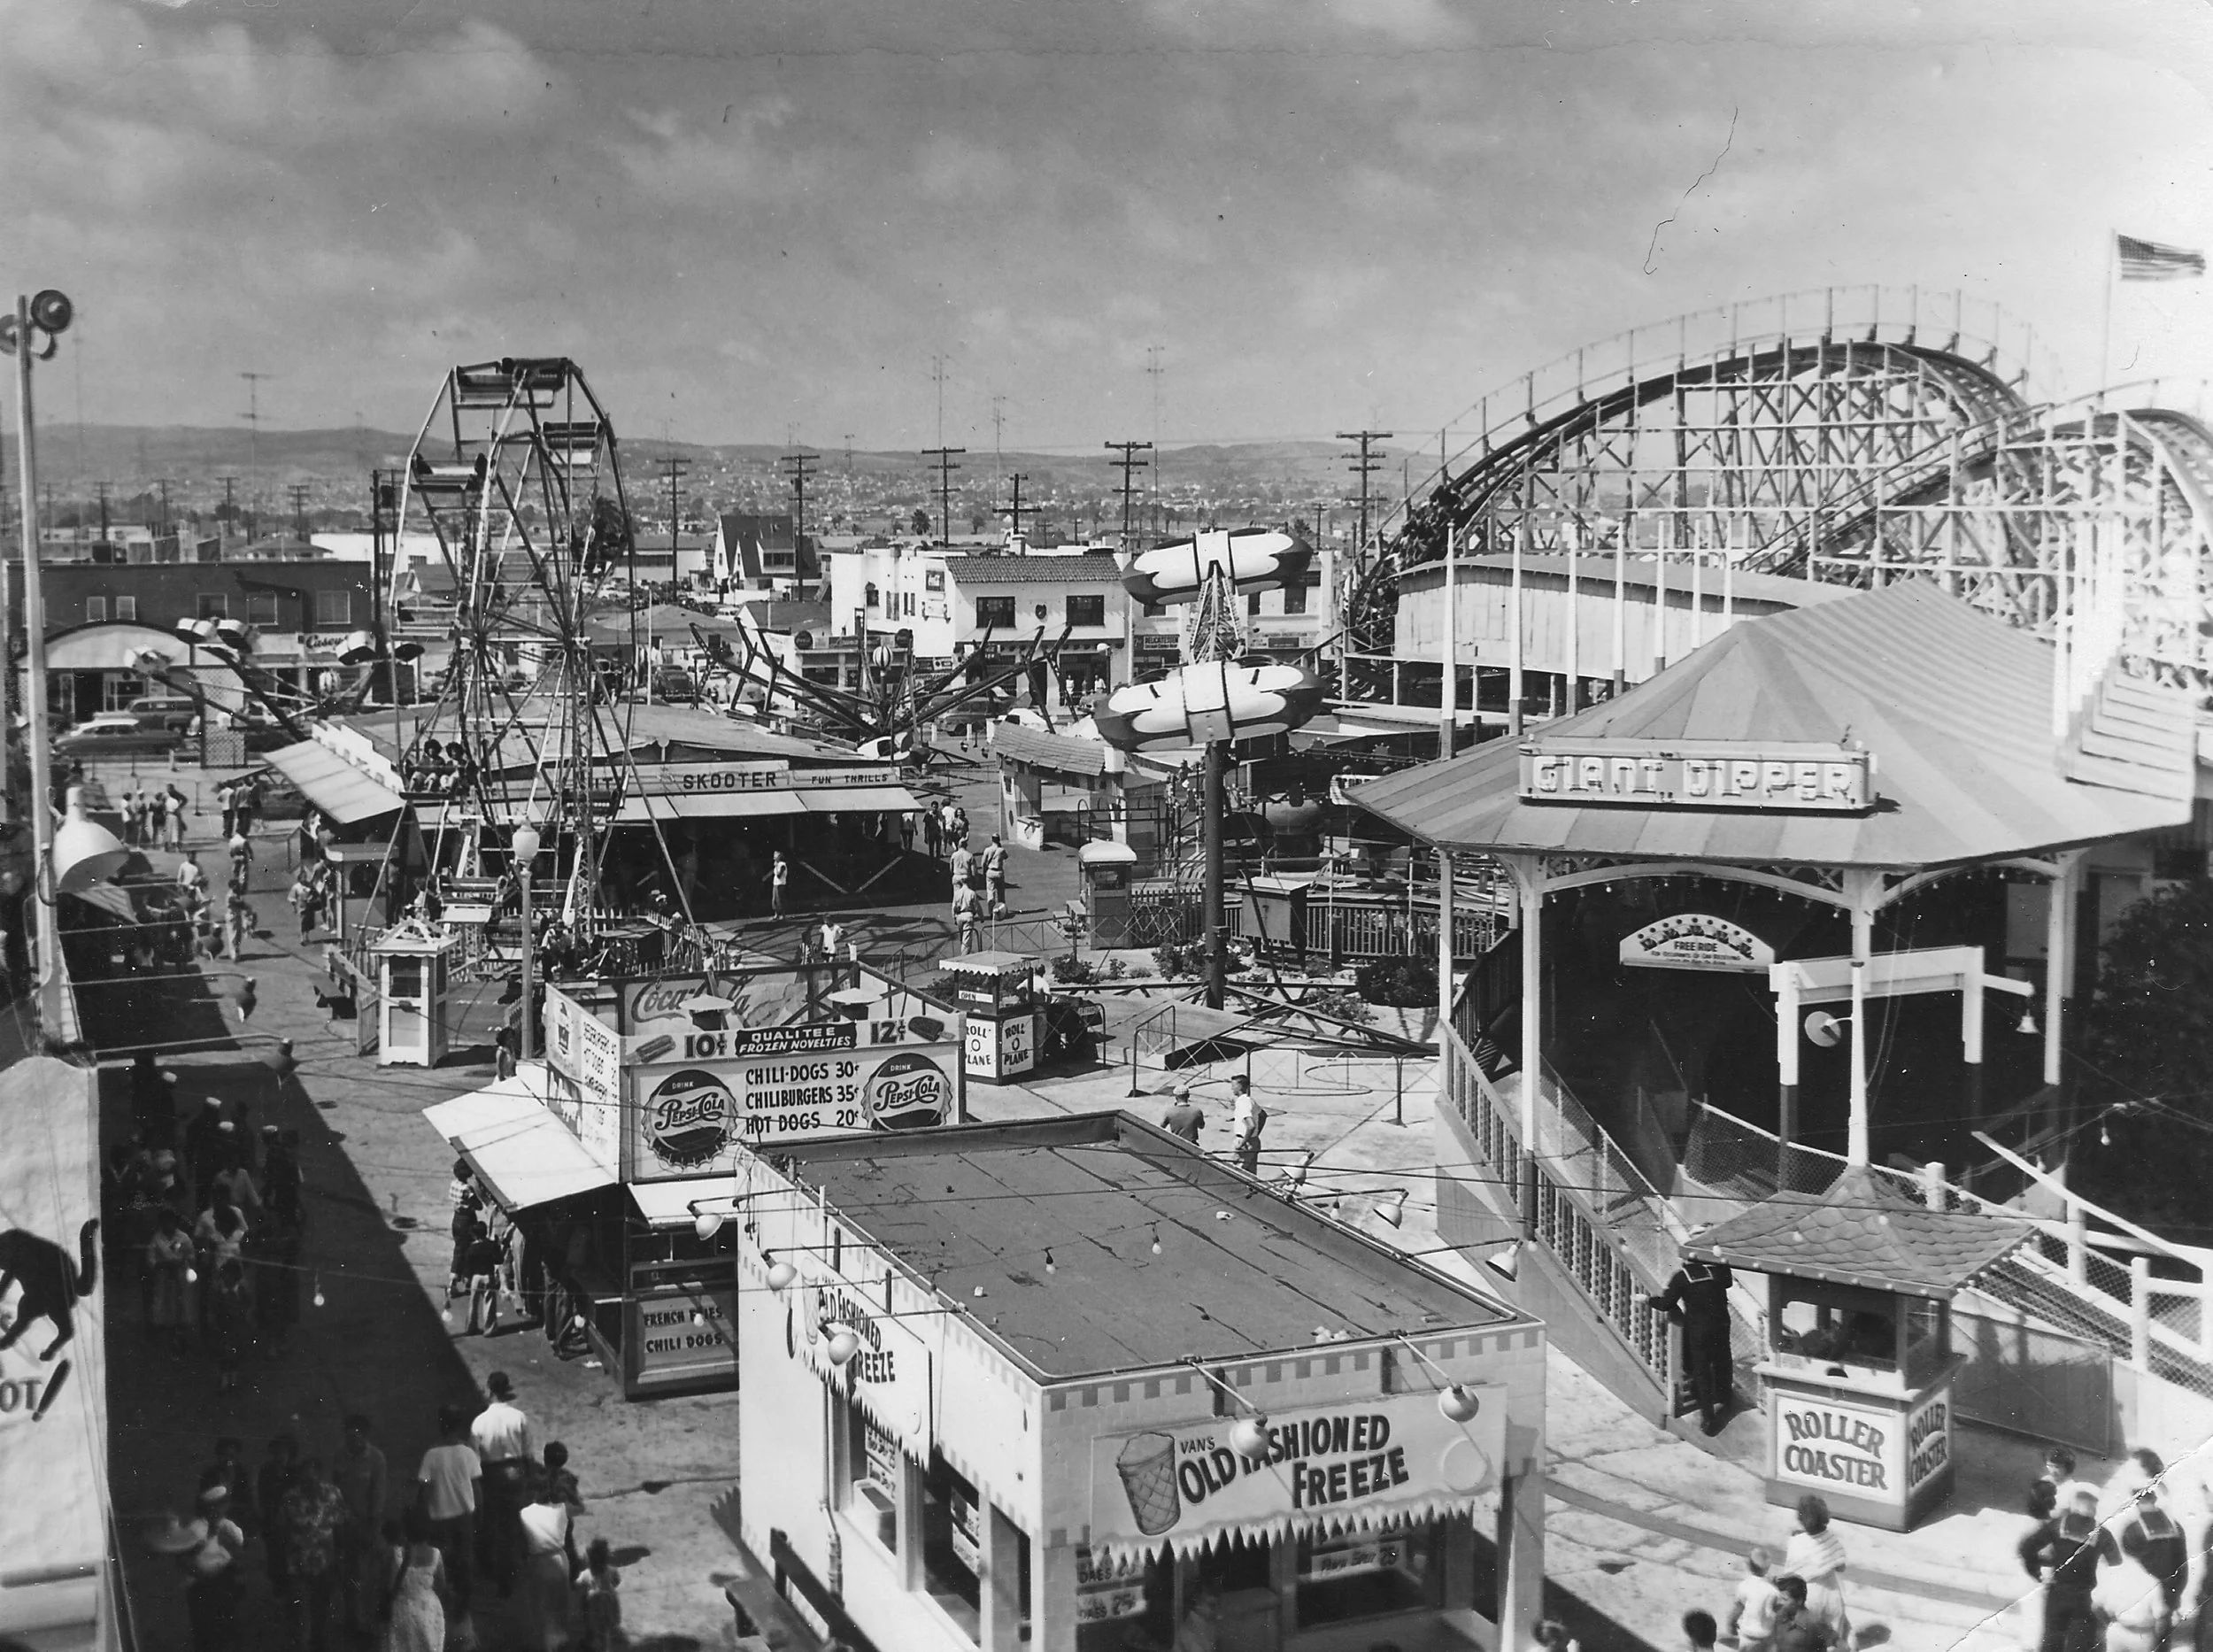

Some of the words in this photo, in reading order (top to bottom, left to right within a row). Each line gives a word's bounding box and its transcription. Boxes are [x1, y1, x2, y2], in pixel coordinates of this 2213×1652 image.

[682, 771, 776, 790] SKOOTER
[811, 776, 832, 784] FUN
[844, 774, 889, 784] THRILLS
[1532, 755, 1663, 792] GIANT
[1682, 759, 1849, 800] DIPPER
[1673, 941, 1696, 951] FREE
[1697, 942, 1718, 952] RIDE
[960, 992, 976, 1001] OPEN
[752, 1026, 836, 1044] QUALITEE
[1005, 1023, 1026, 1039] ROLL
[738, 1040, 788, 1054] FROZEN
[790, 1036, 852, 1050] NOVELTIES
[971, 1038, 981, 1052] O
[1011, 1037, 1021, 1052] O
[965, 1054, 991, 1066] LANE
[1004, 1048, 1029, 1066] PLANE
[672, 1081, 694, 1090] DRINK
[745, 1085, 833, 1110] CHILIBURGERS
[746, 1114, 772, 1135] HOT
[779, 1111, 821, 1132] DOGS
[643, 1309, 685, 1326] FRENCH
[689, 1306, 723, 1323] FIES
[645, 1336, 682, 1354] CHILI
[686, 1332, 723, 1348] DOGS
[857, 1348, 897, 1384] REEZE
[1785, 1410, 1885, 1460] ROLLER
[1910, 1402, 1947, 1455] ROLLER
[1785, 1444, 1889, 1491] COASTER
[1911, 1435, 1948, 1488] COASTER
[1178, 1446, 1238, 1506] OLD
[1292, 1445, 1410, 1509] FREEZE
